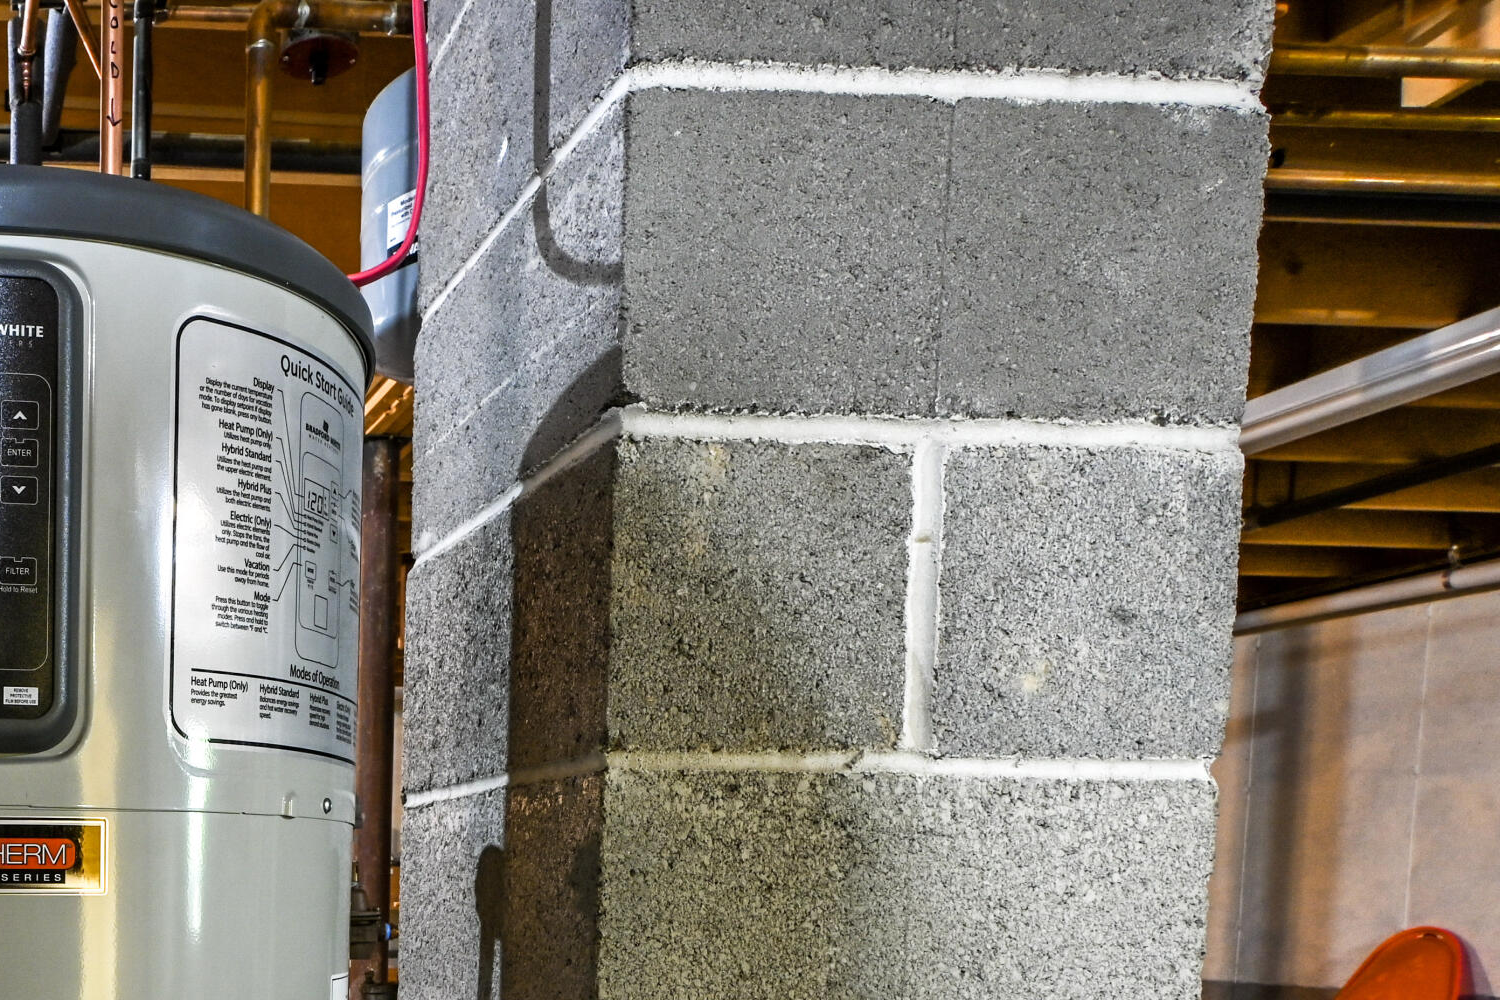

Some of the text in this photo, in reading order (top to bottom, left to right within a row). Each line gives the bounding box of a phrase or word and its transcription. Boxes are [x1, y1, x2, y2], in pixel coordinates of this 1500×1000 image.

[253, 377, 274, 394] Display
[281, 355, 354, 418] Quick Start Guide
[219, 419, 273, 442] Heat Pump (Only)
[7, 448, 32, 457] ENTER
[222, 442, 271, 463] Hybrid Standard
[238, 478, 271, 495] Hybrid Plus
[308, 491, 324, 514] 120
[230, 510, 271, 529] Electric (Only)
[5, 567, 30, 575] FILTER
[244, 558, 270, 571] Vacation
[20, 586, 38, 594] Reset
[254, 591, 270, 603] Mode
[191, 676, 249, 693] Heat Pump (Only)
[289, 664, 340, 690] Modes of Operation
[259, 683, 300, 699] Hybrid Standard
[0, 873, 63, 882] SERIES
